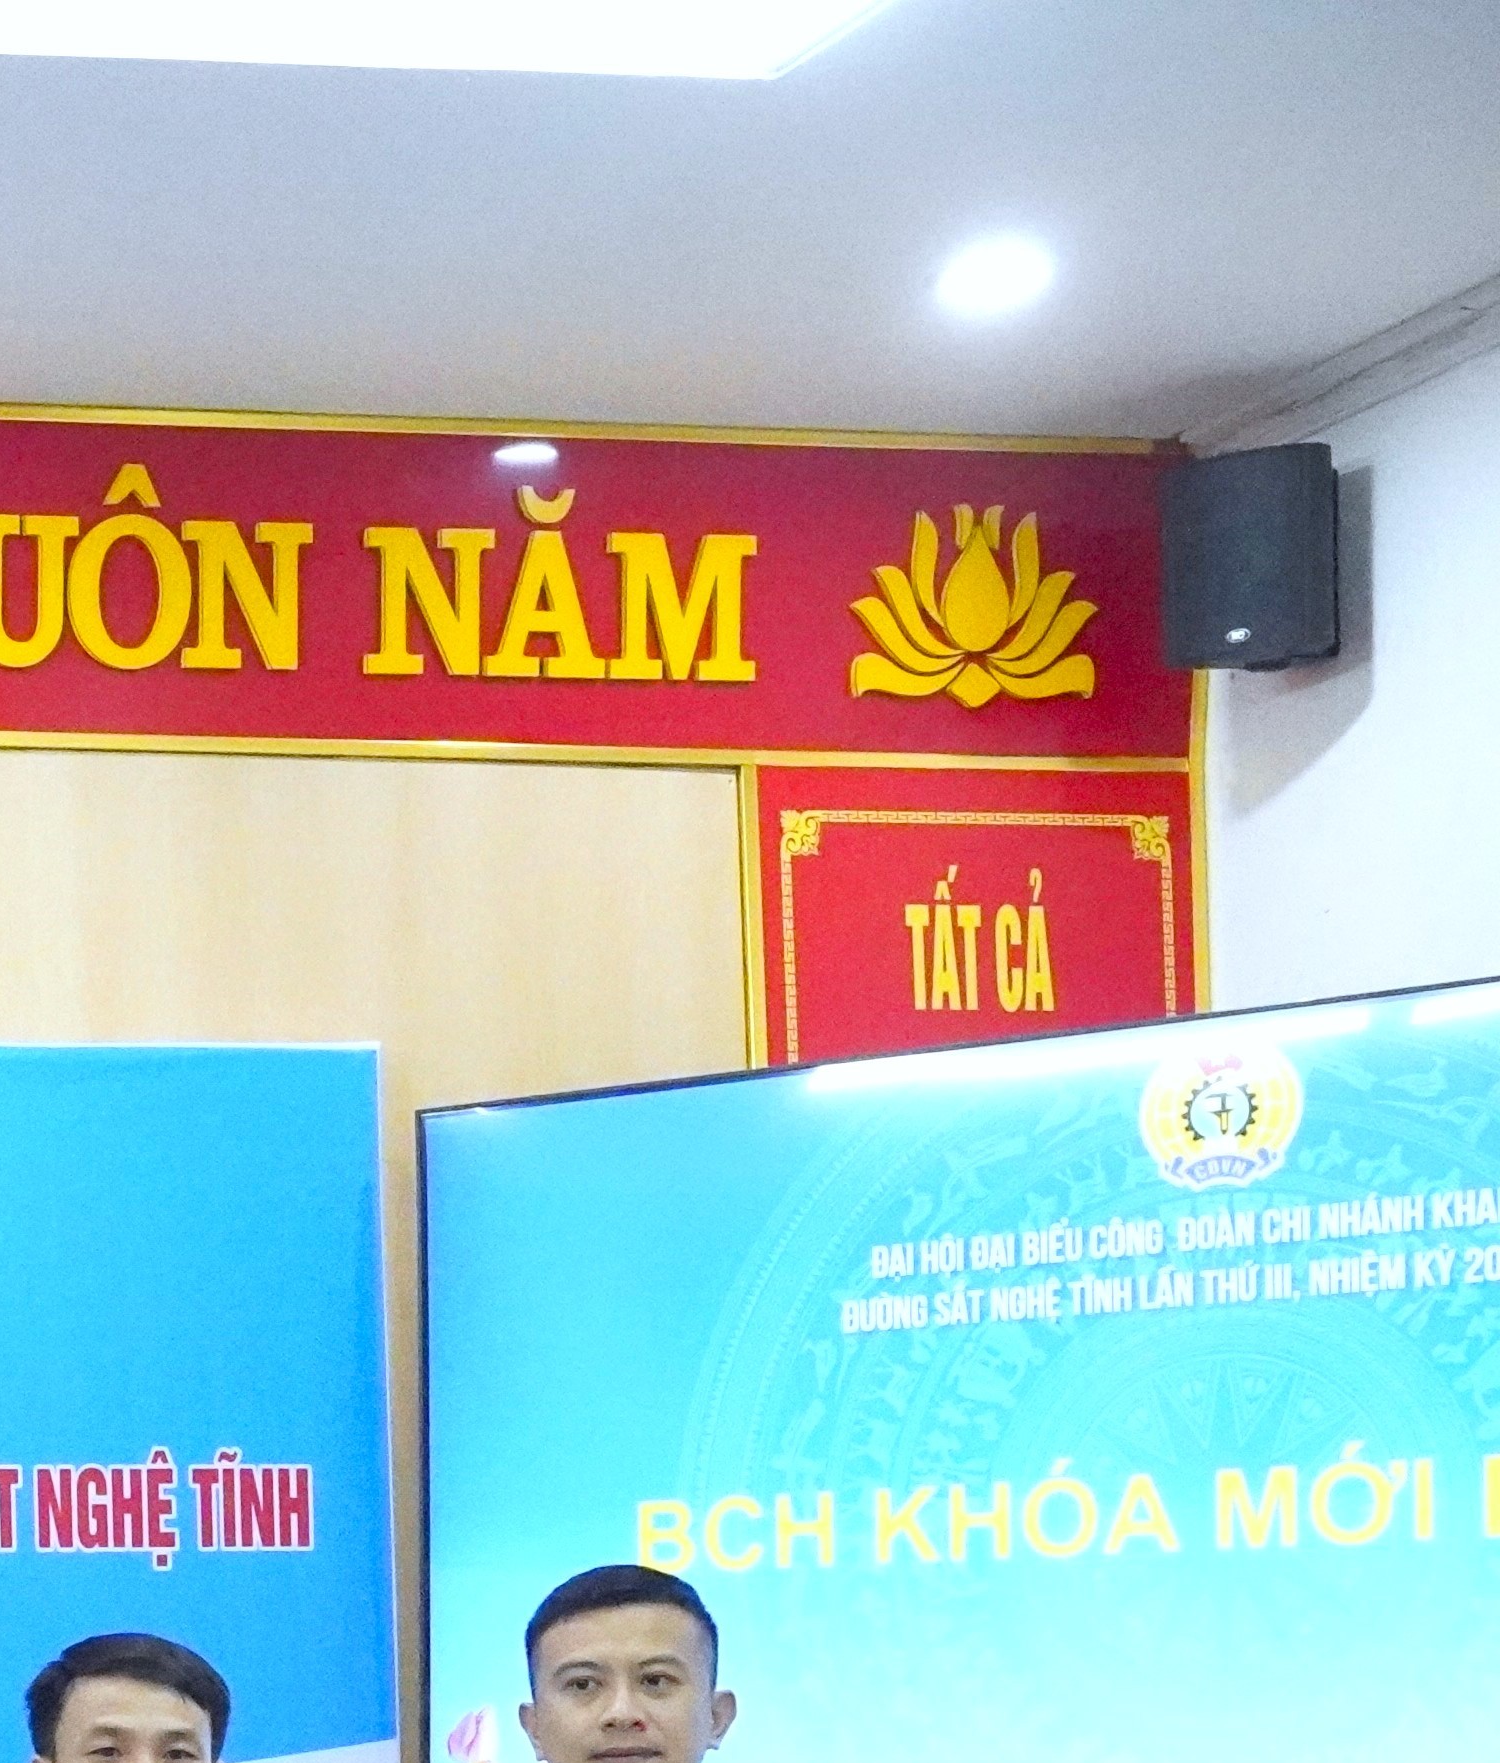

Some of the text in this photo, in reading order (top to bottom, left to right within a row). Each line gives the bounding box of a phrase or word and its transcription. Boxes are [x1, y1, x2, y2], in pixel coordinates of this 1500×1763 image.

[361, 486, 756, 683] NĂM
[905, 865, 1053, 1013] TẤT CẢ
[871, 1186, 1500, 1281] ĐẠI HỘI ĐẠI BIỂU CÔNG ĐOÀN CHI NHÁNH KHA
[990, 1277, 1061, 1323] NGHỆ
[1202, 1260, 1260, 1304] THỨ
[1309, 1250, 1405, 1298] NHIỆM
[36, 1447, 177, 1571] NGHỆ
[190, 1448, 313, 1552] TĨNH
[635, 1490, 834, 1573] BCH
[874, 1457, 1180, 1564] KHÓA
[1215, 1441, 1435, 1549] MỚI
